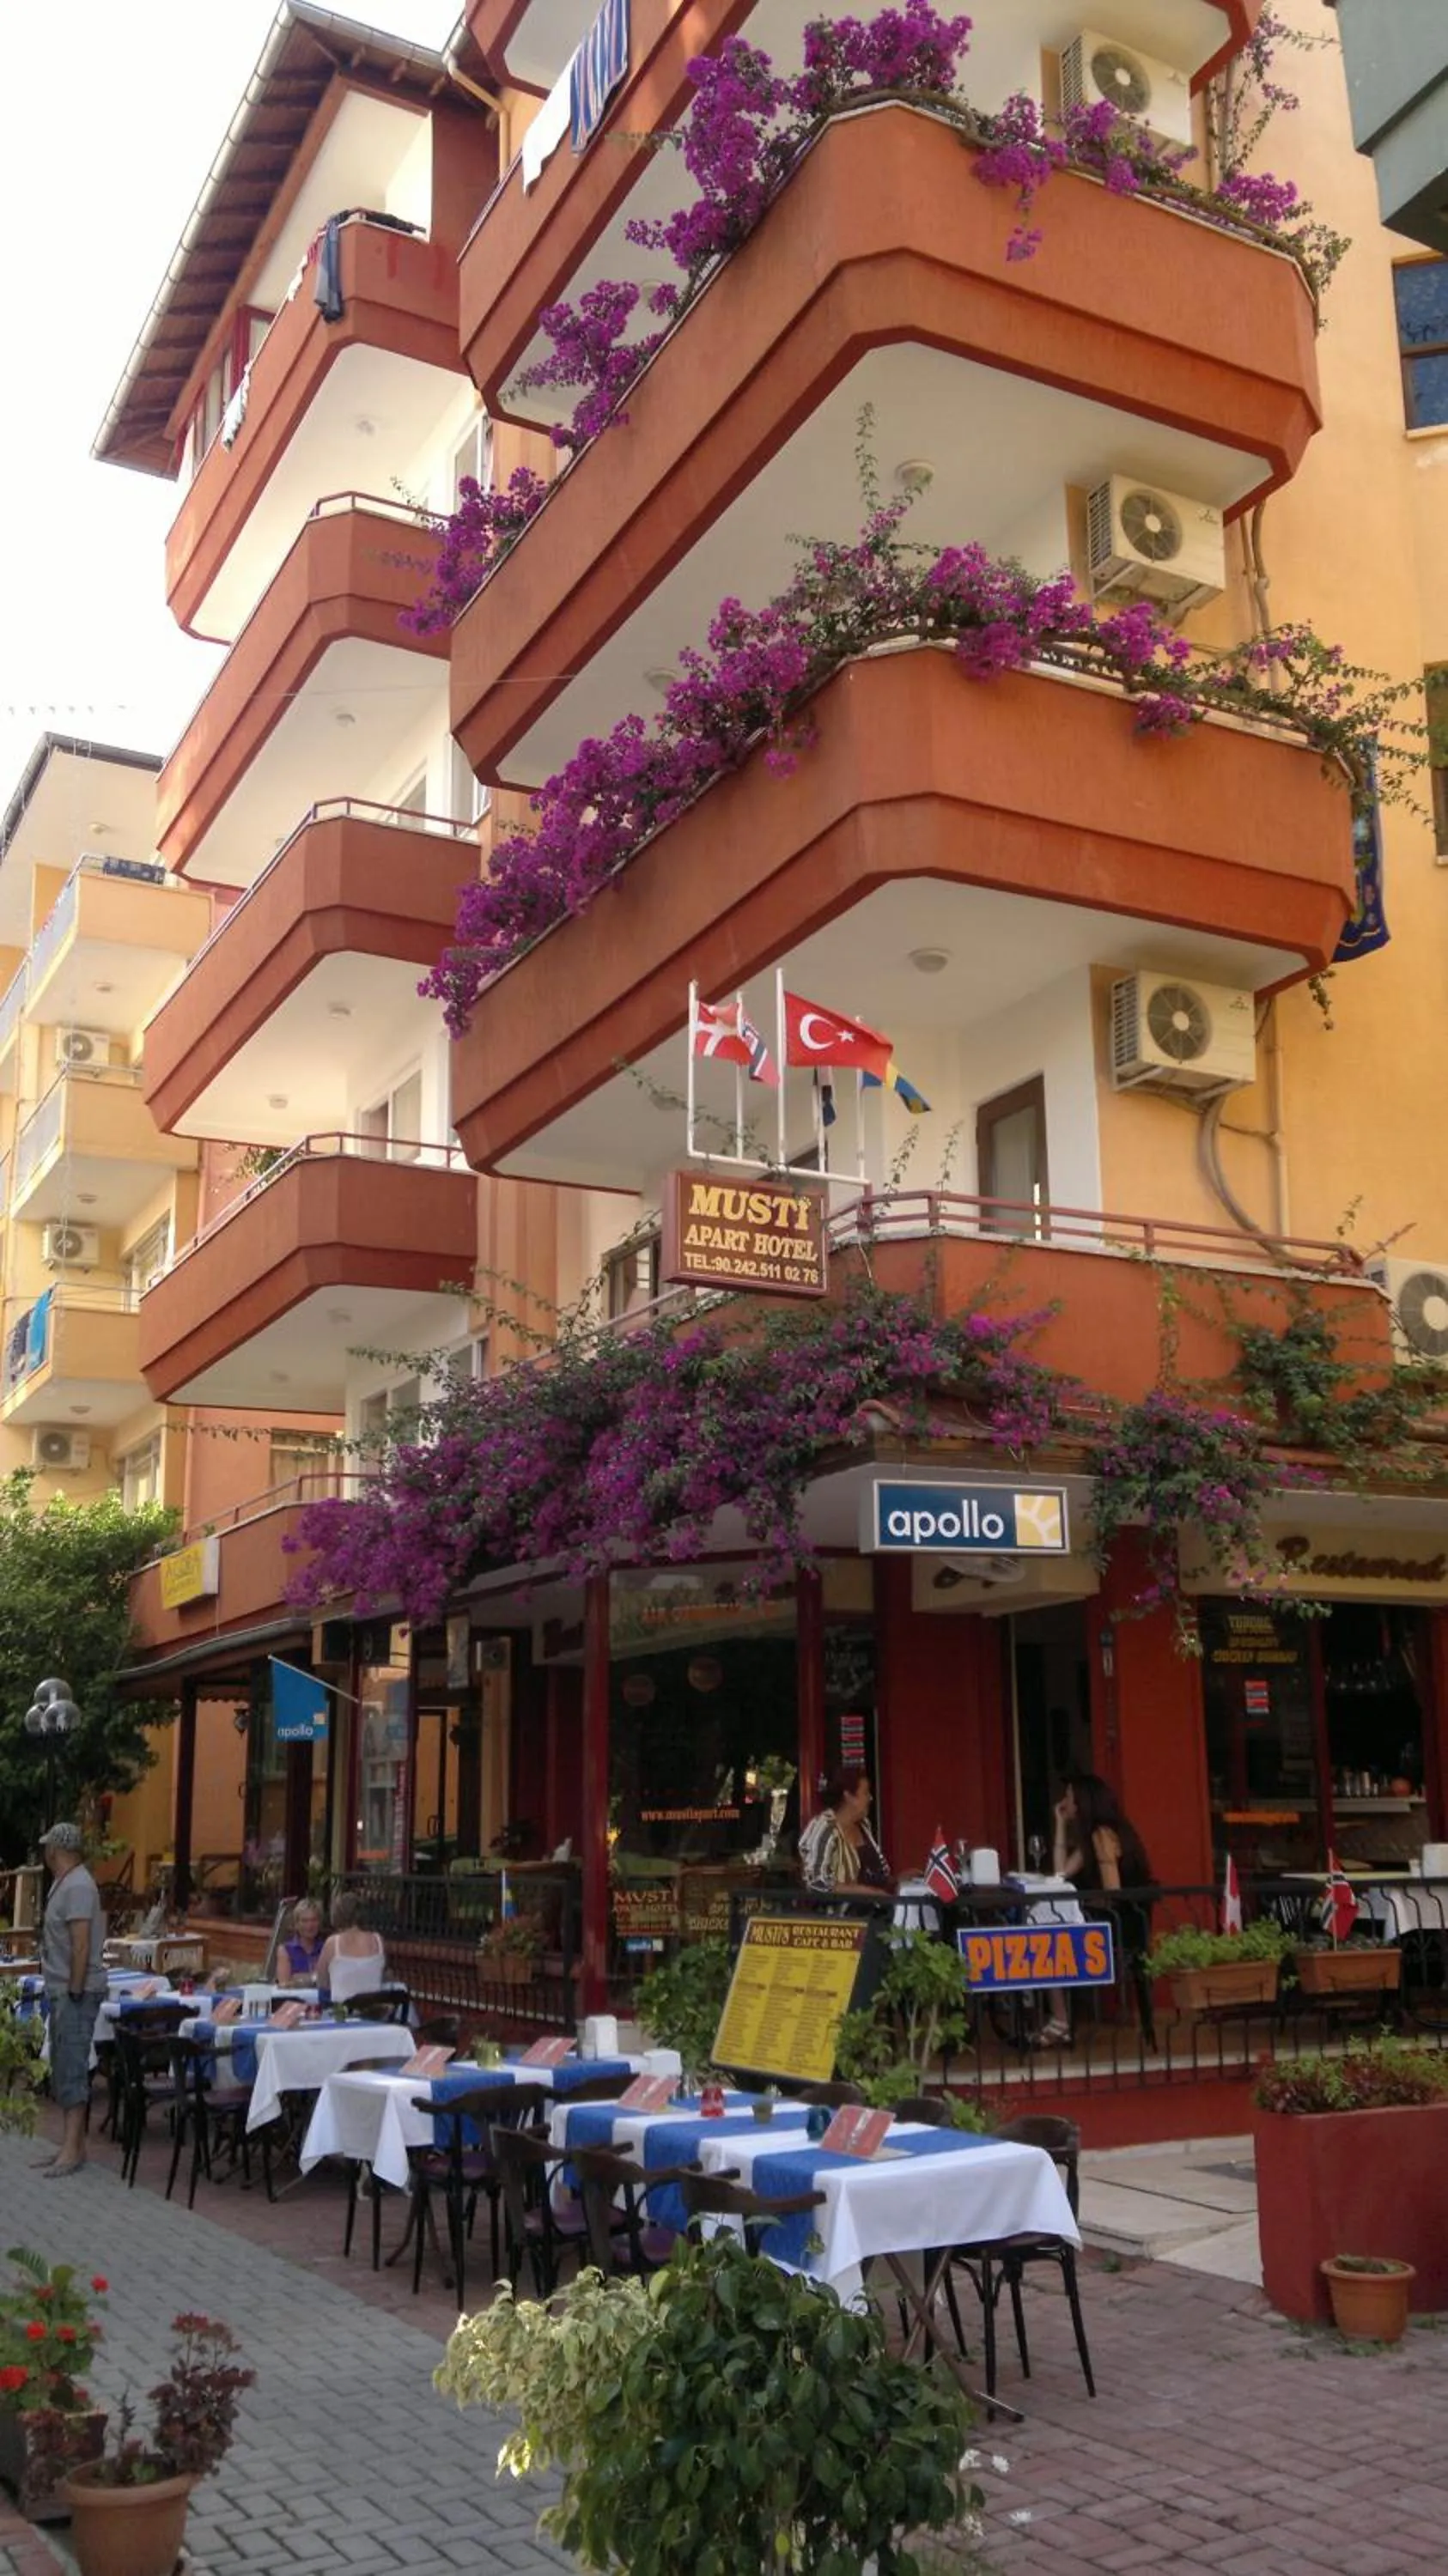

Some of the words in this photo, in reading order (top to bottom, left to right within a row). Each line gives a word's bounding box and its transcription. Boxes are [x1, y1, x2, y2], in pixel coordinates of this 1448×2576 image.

[684, 1224, 750, 1253] APART
[753, 1233, 818, 1261] HOTEL
[887, 1499, 1005, 1544] apollo
